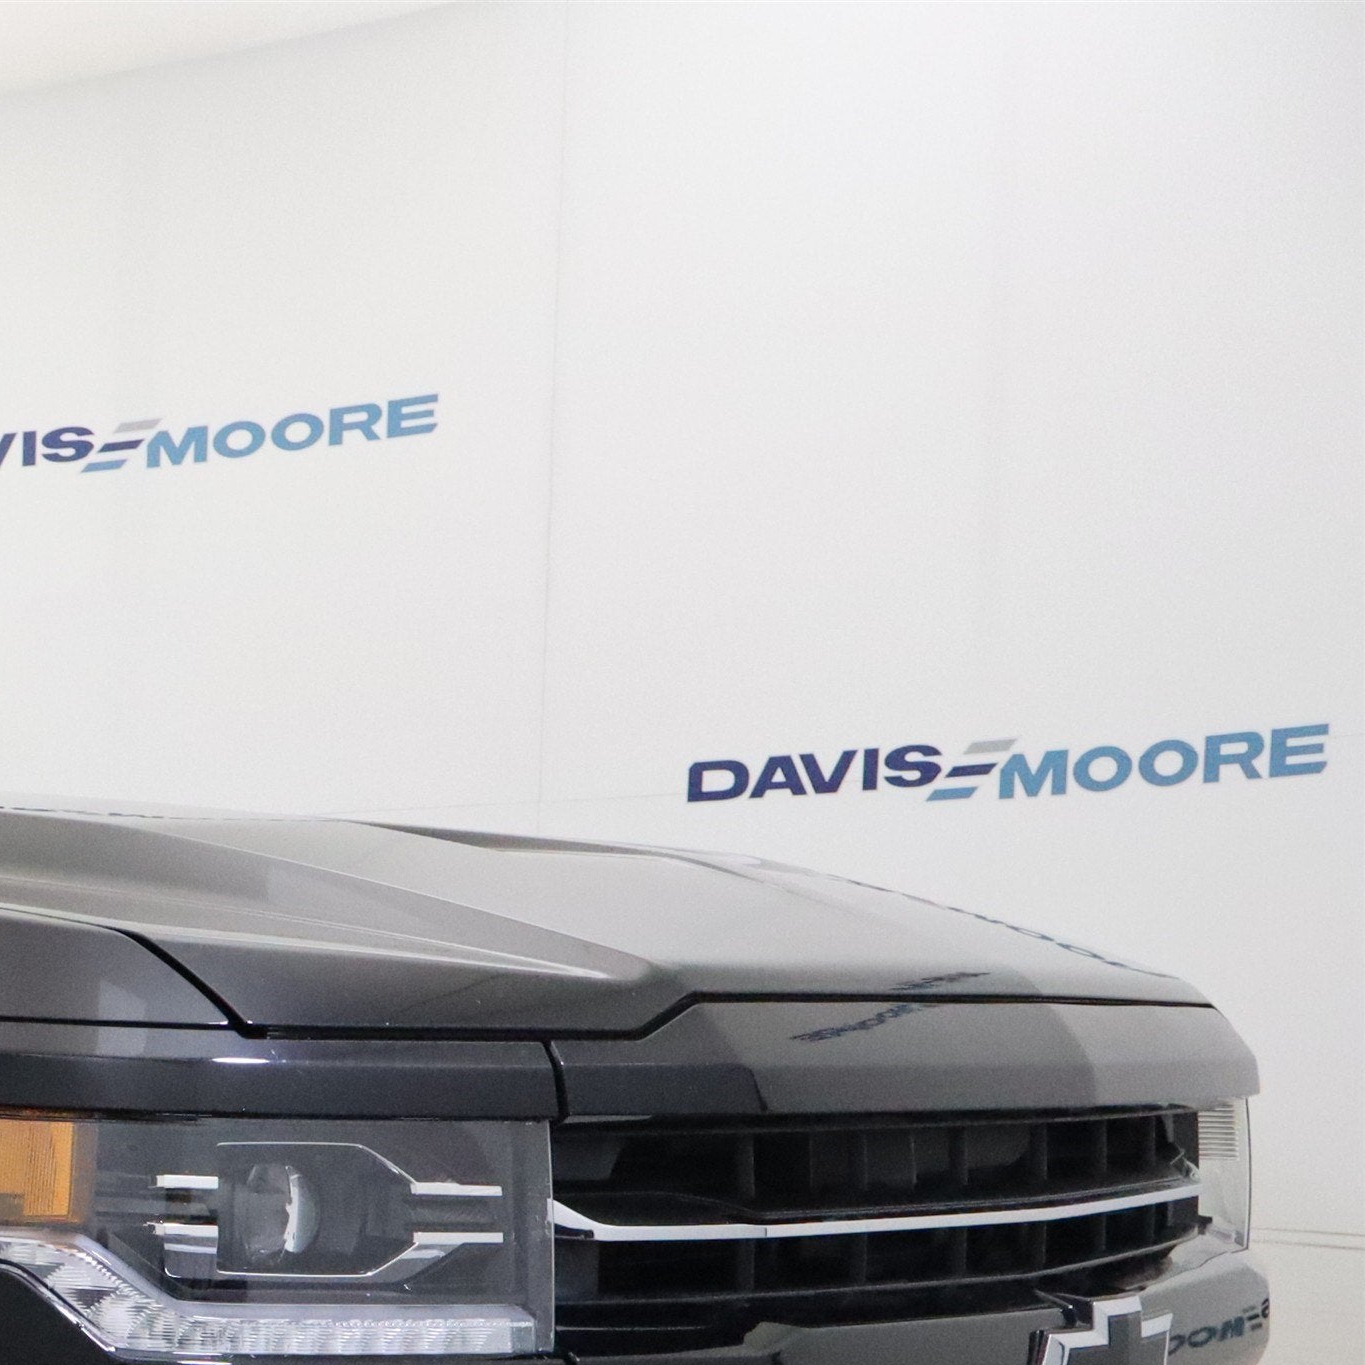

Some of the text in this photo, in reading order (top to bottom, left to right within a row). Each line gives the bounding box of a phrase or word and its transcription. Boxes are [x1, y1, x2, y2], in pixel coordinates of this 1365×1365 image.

[146, 393, 439, 469] MOORE
[686, 723, 1330, 802] DAVIS MOORE
